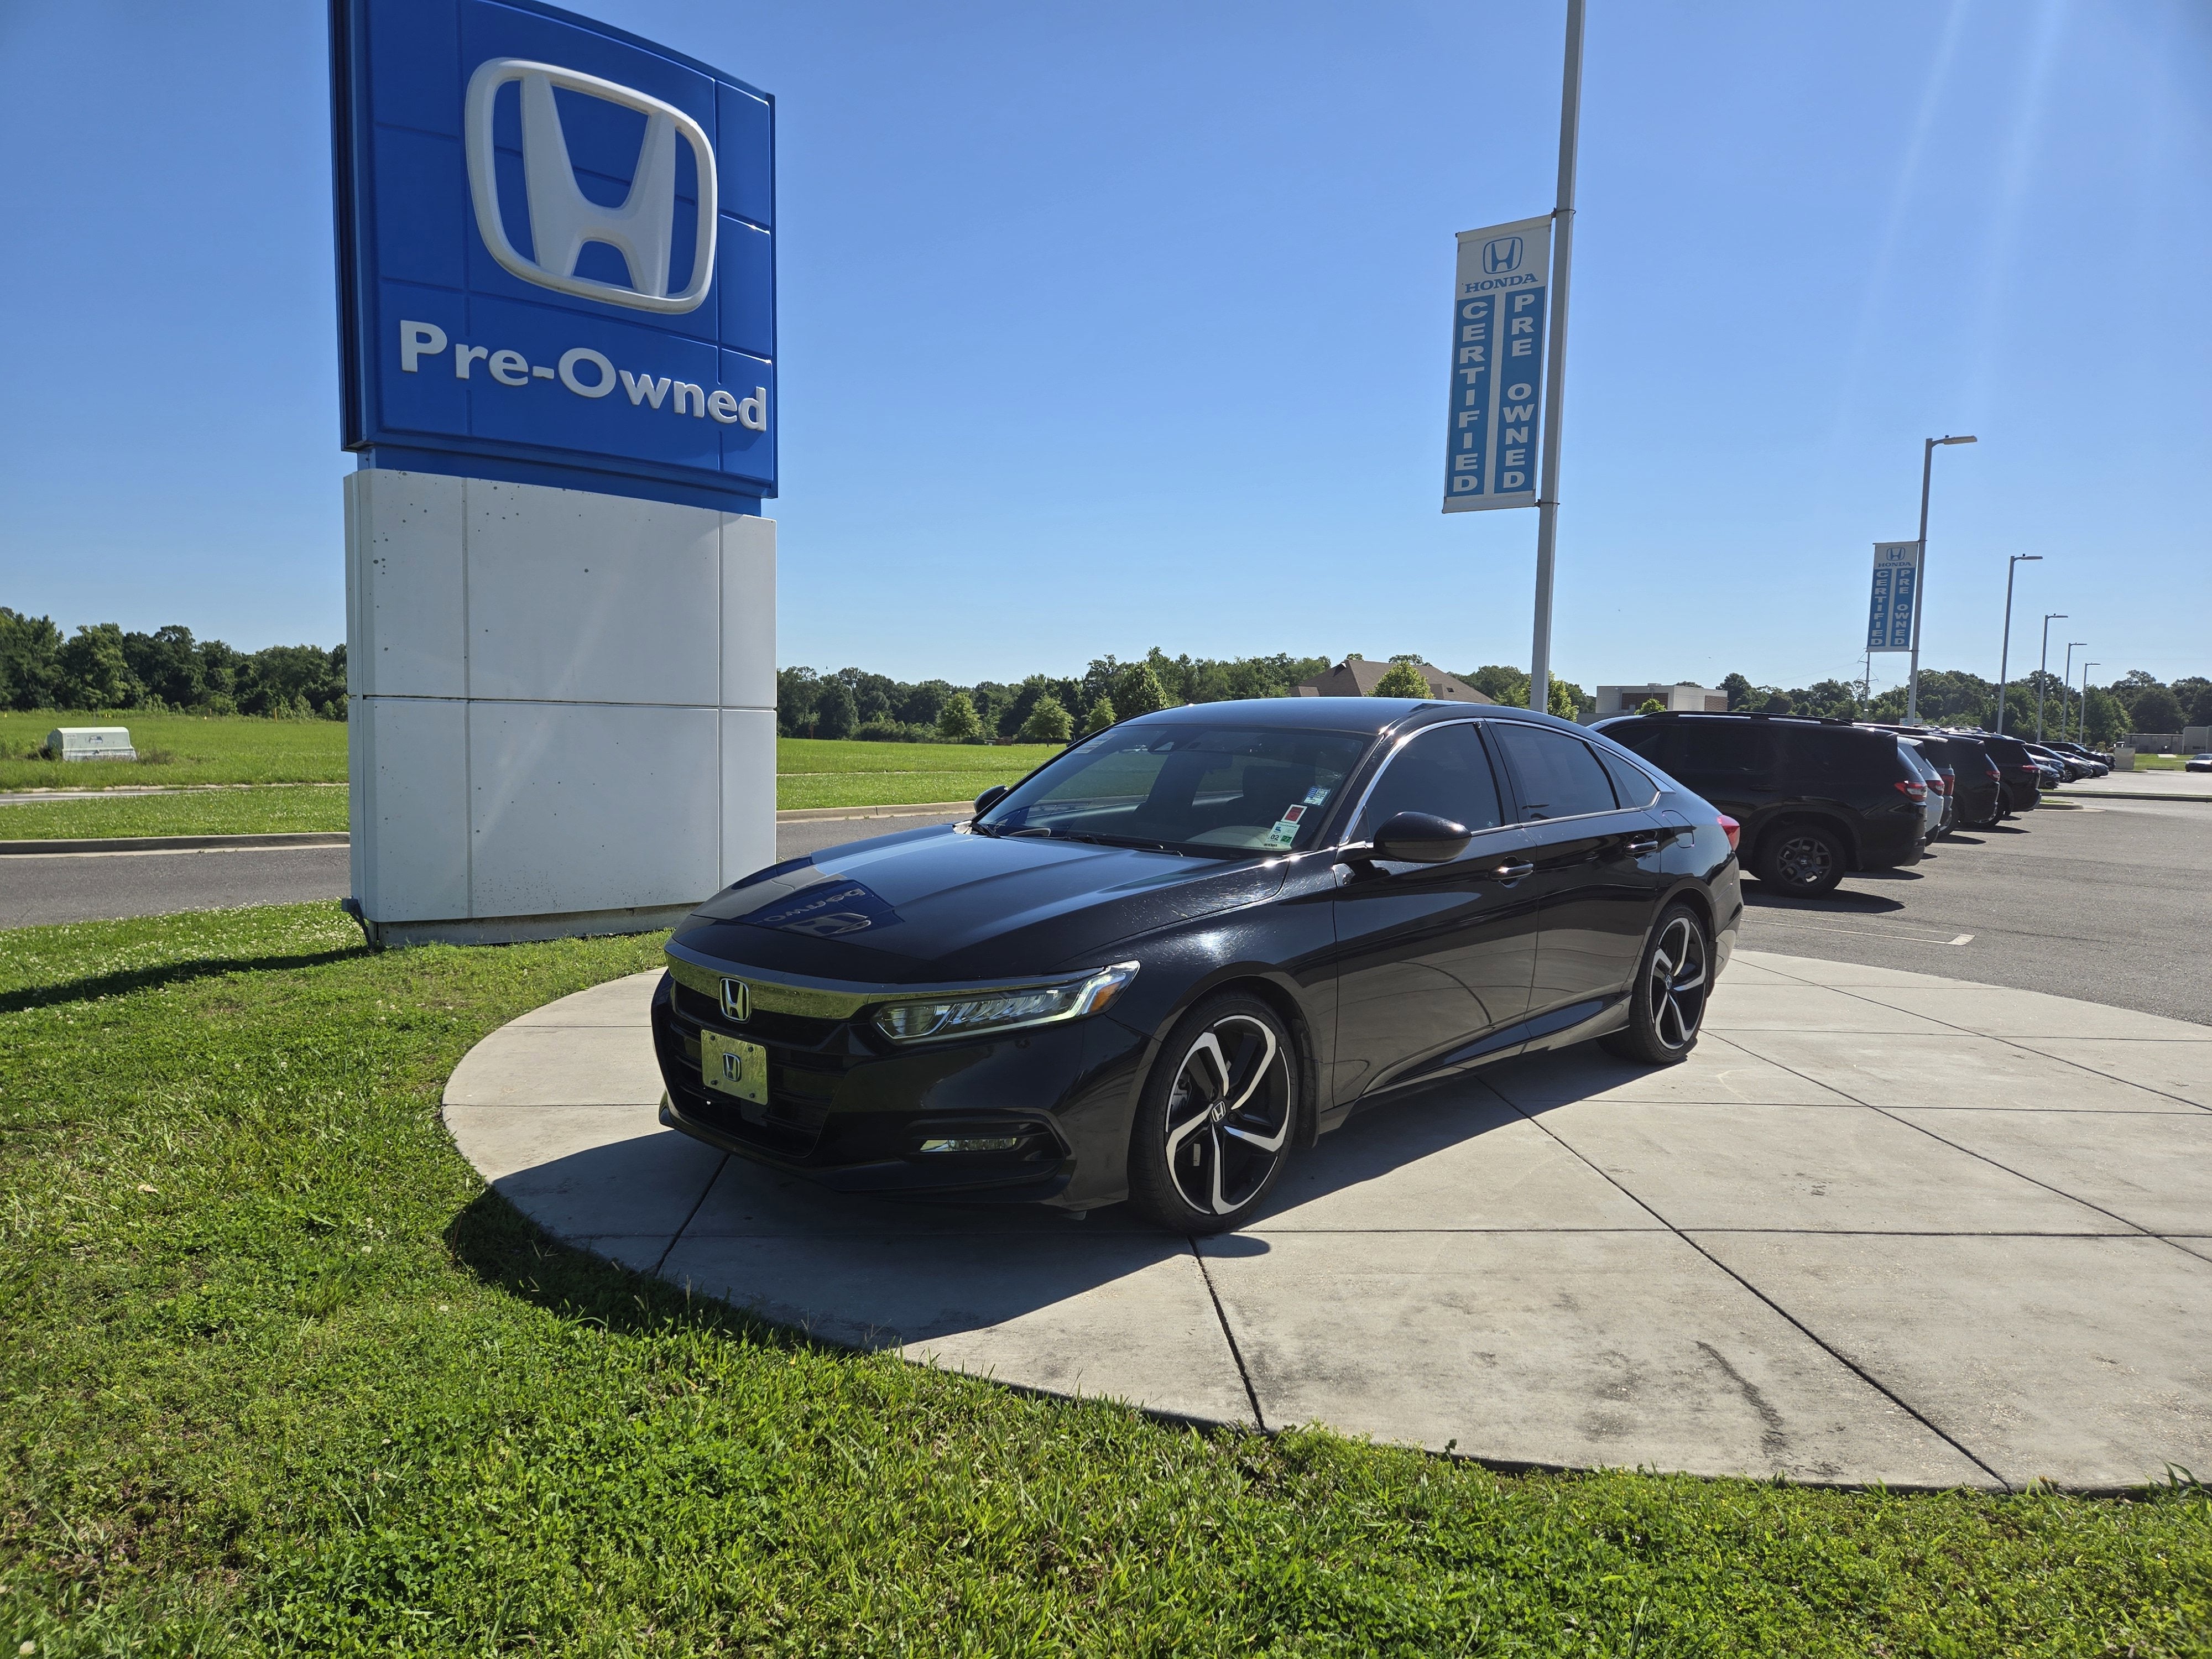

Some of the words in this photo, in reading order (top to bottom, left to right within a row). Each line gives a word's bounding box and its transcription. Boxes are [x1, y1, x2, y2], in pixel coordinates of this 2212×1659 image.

[1464, 273, 1538, 293] HONDA
[1511, 294, 1535, 357] PRE
[400, 320, 767, 431] Pre-Owned
[1453, 301, 1489, 492] CERTIFIED
[1503, 383, 1535, 488] OWNED
[1871, 570, 1889, 645] CERTIFIED
[1899, 570, 1911, 594] PRE
[1894, 604, 1910, 645] OWNED
